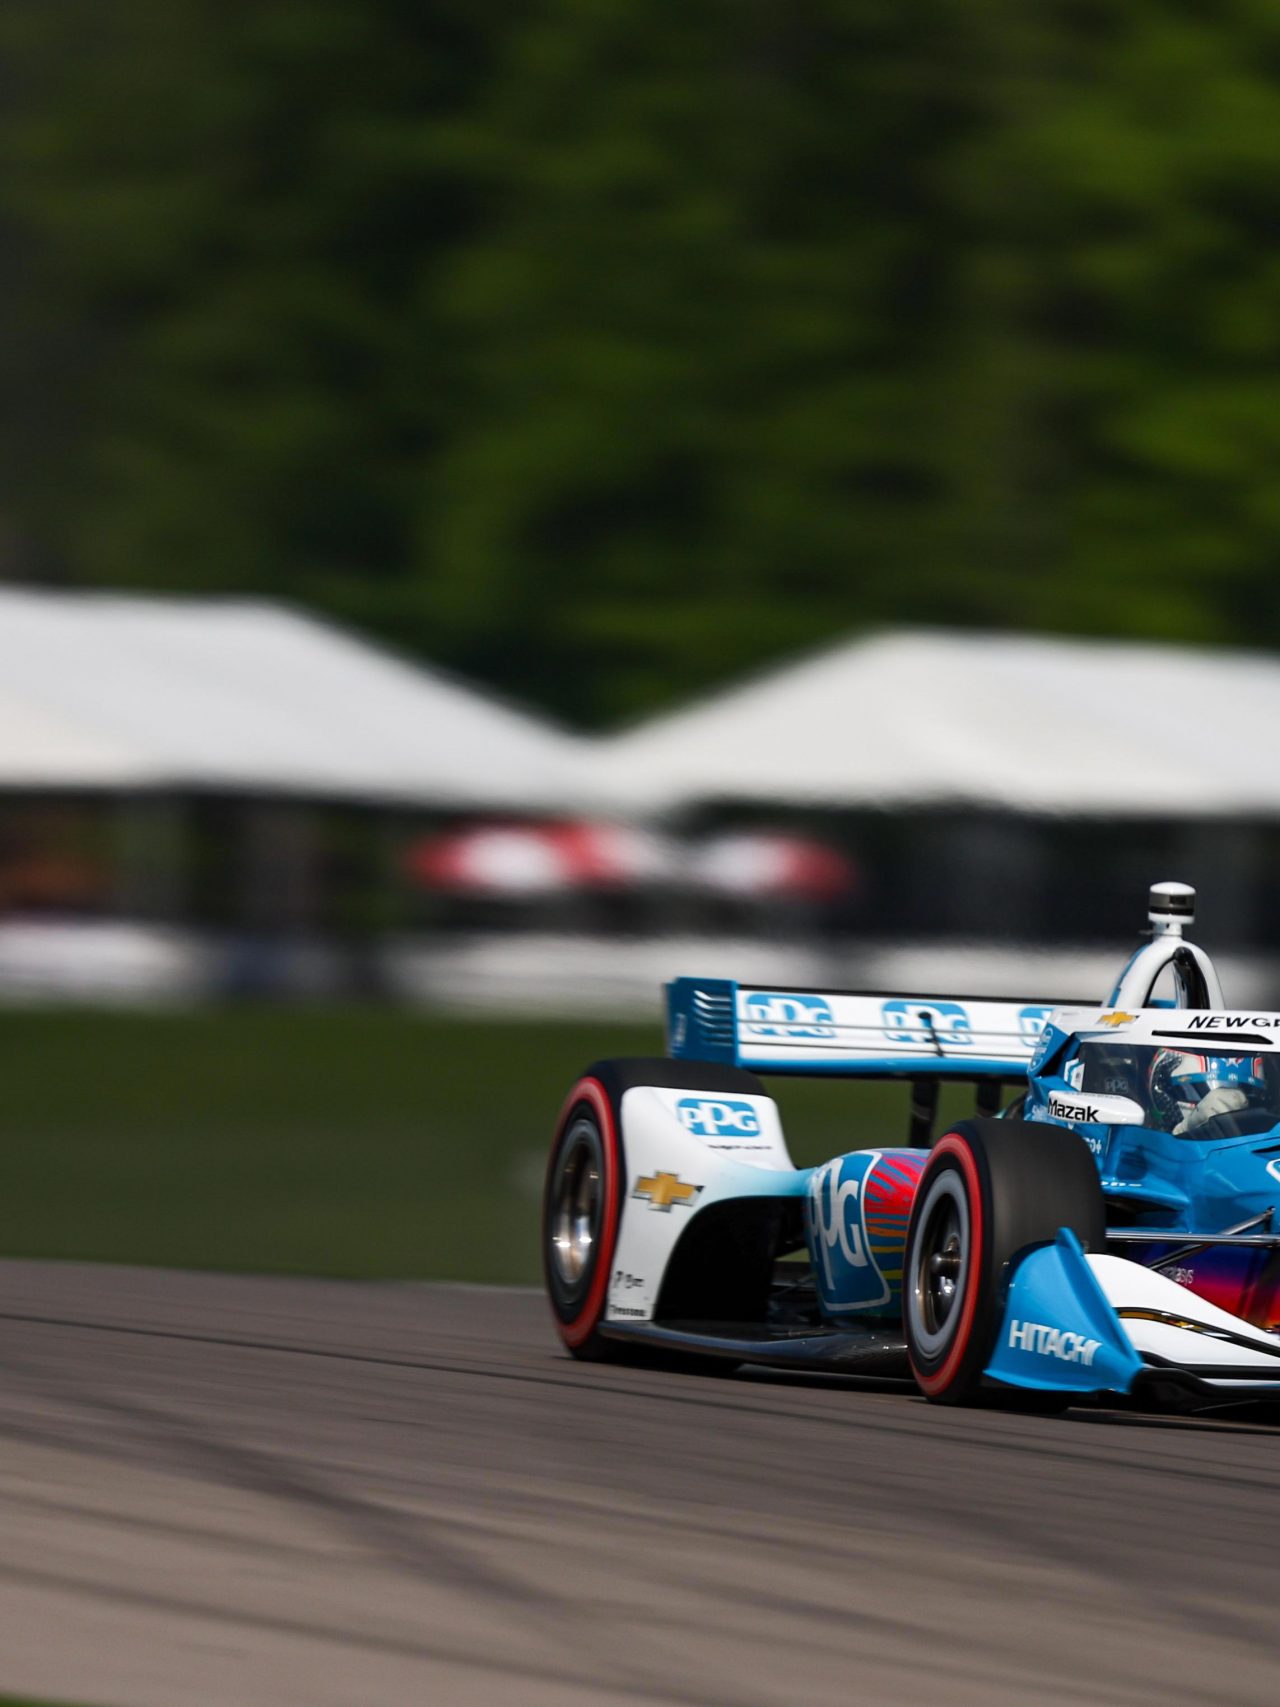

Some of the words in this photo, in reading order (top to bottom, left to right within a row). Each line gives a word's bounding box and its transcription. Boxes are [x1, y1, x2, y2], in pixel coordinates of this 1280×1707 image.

[747, 996, 833, 1037] PPG
[884, 1004, 971, 1044] PPG
[679, 1100, 759, 1135] PPG
[1048, 1098, 1100, 1123] Mazak
[1009, 1319, 1102, 1367] HITACHI
